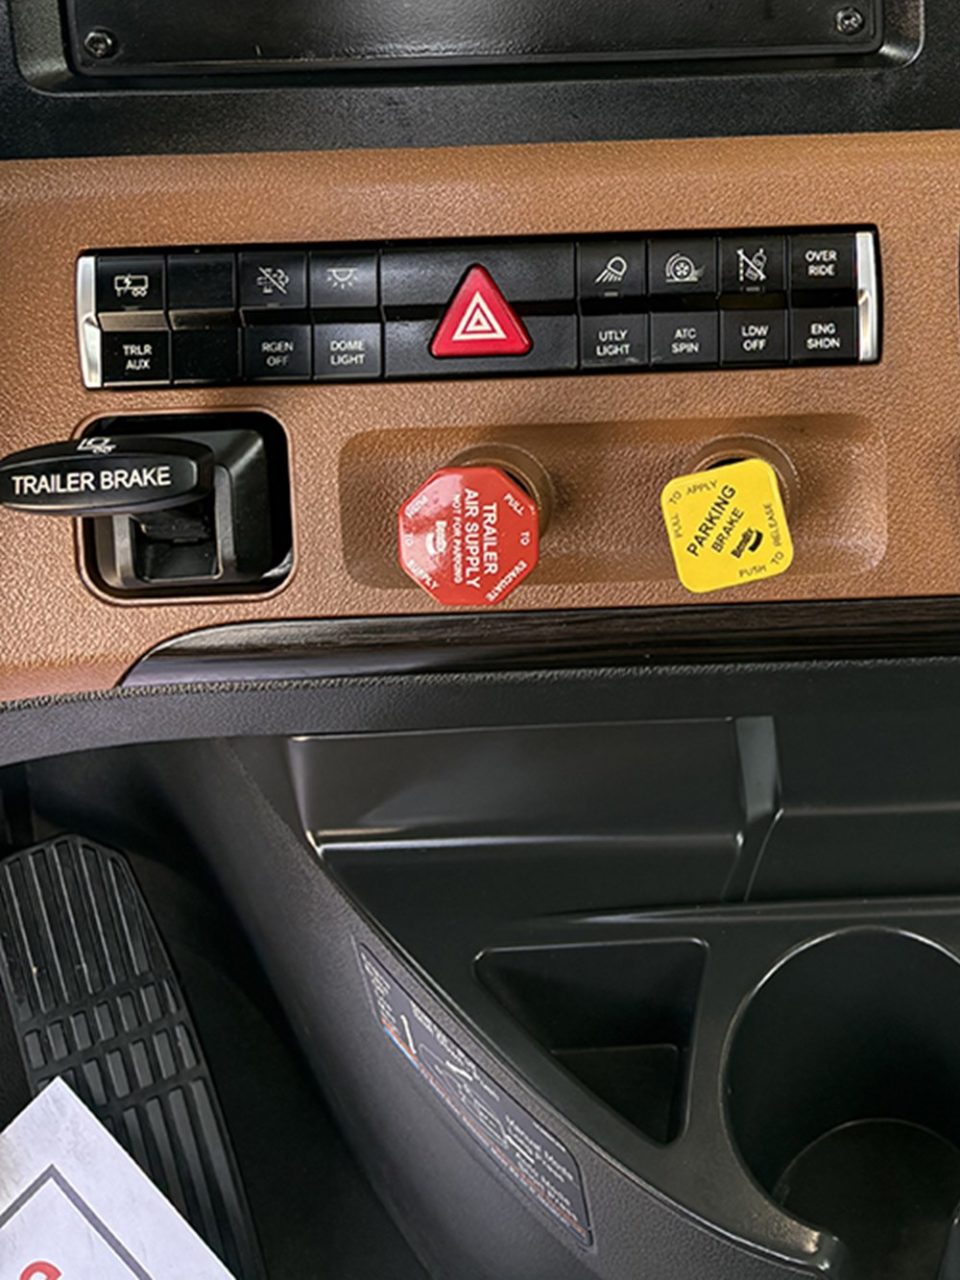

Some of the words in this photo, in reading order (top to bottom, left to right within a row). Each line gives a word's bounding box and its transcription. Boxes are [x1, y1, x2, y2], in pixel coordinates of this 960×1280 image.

[805, 250, 837, 262] OVER
[808, 264, 835, 277] RIDE
[674, 328, 696, 340] ATC
[741, 325, 769, 337] LOW
[810, 323, 836, 335] ENG
[598, 330, 628, 343] UTLY
[123, 344, 152, 356] TRLR
[261, 342, 293, 353] RGEN
[330, 340, 365, 352] DOME
[596, 344, 631, 357] LIGHT
[671, 342, 699, 354] SPIN
[743, 339, 766, 351] OFF
[125, 359, 150, 370] AUX
[266, 356, 289, 367] OFF
[330, 353, 365, 366] LIGHT
[12, 472, 96, 496] TRAILER
[100, 466, 172, 490] BRAKE
[686, 480, 718, 496] APPLY
[464, 488, 479, 518] AIR
[668, 490, 683, 505] TO
[503, 493, 525, 517] PULL
[452, 517, 462, 537] FOR
[671, 514, 683, 539] PULL
[686, 484, 737, 557] PARKING
[763, 503, 782, 547] RELEASE
[711, 507, 745, 553] BRAKE
[482, 502, 498, 575] TRAILER
[520, 531, 530, 546] TO
[464, 522, 481, 588] SUPPLY
[770, 551, 785, 565] TO
[738, 564, 767, 578] PUSH
[485, 560, 528, 602] EVACUATE
